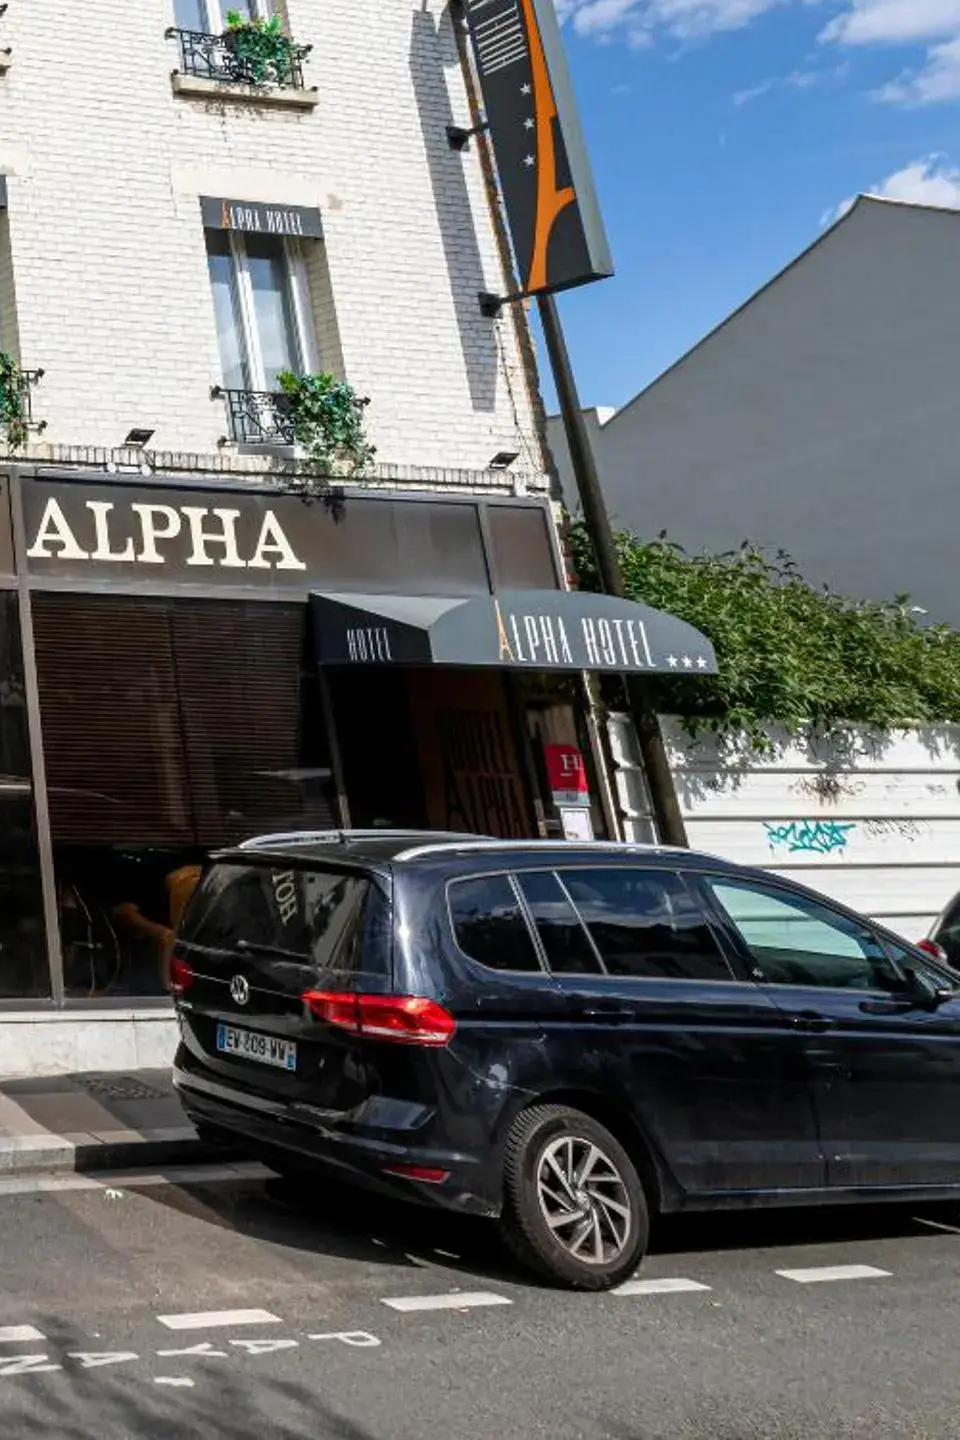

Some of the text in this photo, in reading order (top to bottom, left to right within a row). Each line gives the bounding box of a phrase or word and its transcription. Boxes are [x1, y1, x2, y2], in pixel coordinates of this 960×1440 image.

[474, 1, 528, 76] HOTEL
[221, 201, 303, 234] ALPHA HOTEL
[26, 496, 308, 571] ALPHA
[346, 627, 392, 662] HOTEL
[494, 599, 657, 667] ALPHA HOTEL
